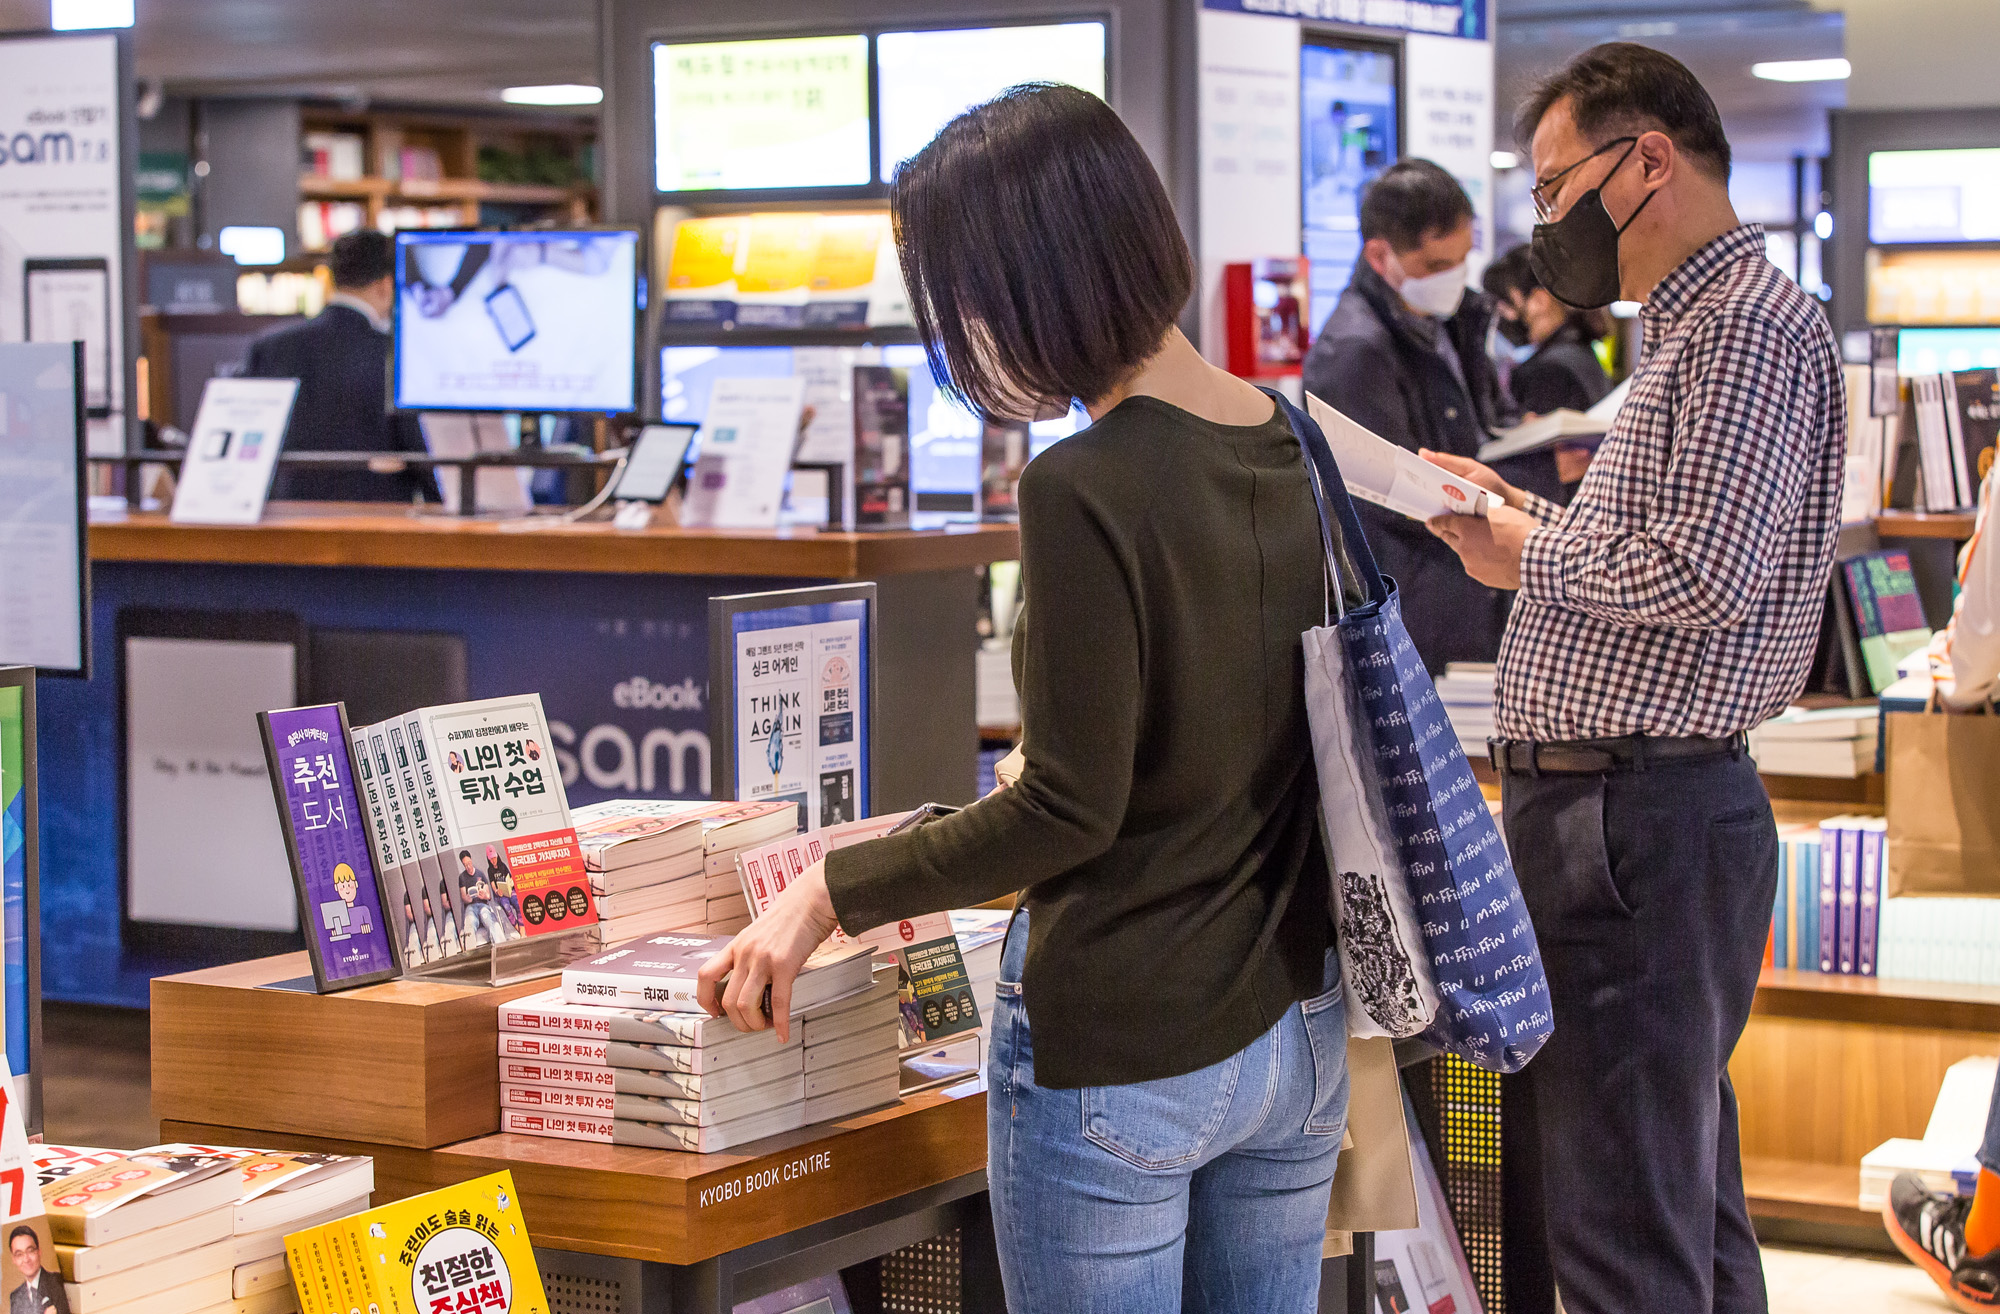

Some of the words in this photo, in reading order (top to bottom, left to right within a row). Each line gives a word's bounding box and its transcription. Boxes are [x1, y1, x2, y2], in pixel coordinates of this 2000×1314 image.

[752, 660, 770, 677] 싱크
[772, 656, 798, 675] 어게인
[612, 676, 702, 710] eBook
[750, 691, 800, 714] THINK
[751, 714, 801, 737] AGAIN
[463, 743, 502, 771] 나의
[504, 740, 527, 766] 첫
[548, 719, 711, 794] sam
[294, 753, 340, 793] 추천
[402, 770, 415, 792] 나의
[421, 764, 433, 786] 나의
[366, 782, 379, 804] 나의
[385, 777, 396, 799] 나의
[427, 787, 437, 799] 첫
[460, 774, 501, 804] 투자
[504, 767, 545, 798] 수업
[390, 800, 400, 812] 첫
[408, 793, 418, 806] 첫
[303, 795, 348, 830] 도서
[372, 805, 383, 818] 첫
[413, 807, 425, 829] 투자
[431, 801, 443, 823] 투자
[376, 819, 388, 841] 투자
[394, 814, 406, 836] 투자
[437, 825, 449, 847] 수업
[400, 838, 412, 860] 수업
[418, 832, 430, 853] 수업
[382, 843, 394, 865] 수업
[542, 1016, 561, 1028] 나의
[563, 1017, 572, 1029] 첫
[574, 1018, 592, 1031] 투자
[542, 1042, 560, 1054] 나의
[563, 1044, 572, 1056] 첫
[574, 1045, 592, 1058] 투자
[594, 1047, 606, 1059] 수
[543, 1068, 562, 1080] 나의
[563, 1069, 573, 1081] 첫
[575, 1070, 593, 1083] 투자
[595, 1072, 613, 1085] 수업
[545, 1092, 563, 1105] 나의
[564, 1094, 574, 1106] 첫
[576, 1095, 594, 1108] 투자
[596, 1097, 614, 1110] 수업
[547, 1119, 565, 1131] 나의
[566, 1120, 576, 1132] 첫
[578, 1122, 596, 1134] 투자
[700, 1179, 741, 1208] KYOBO
[746, 1167, 780, 1194] BOOK
[783, 1151, 831, 1181] CENTRE
[399, 1214, 442, 1267] 주린이도
[444, 1209, 471, 1226] 술술
[476, 1213, 500, 1241] 읽는
[419, 1246, 496, 1296] 친절한
